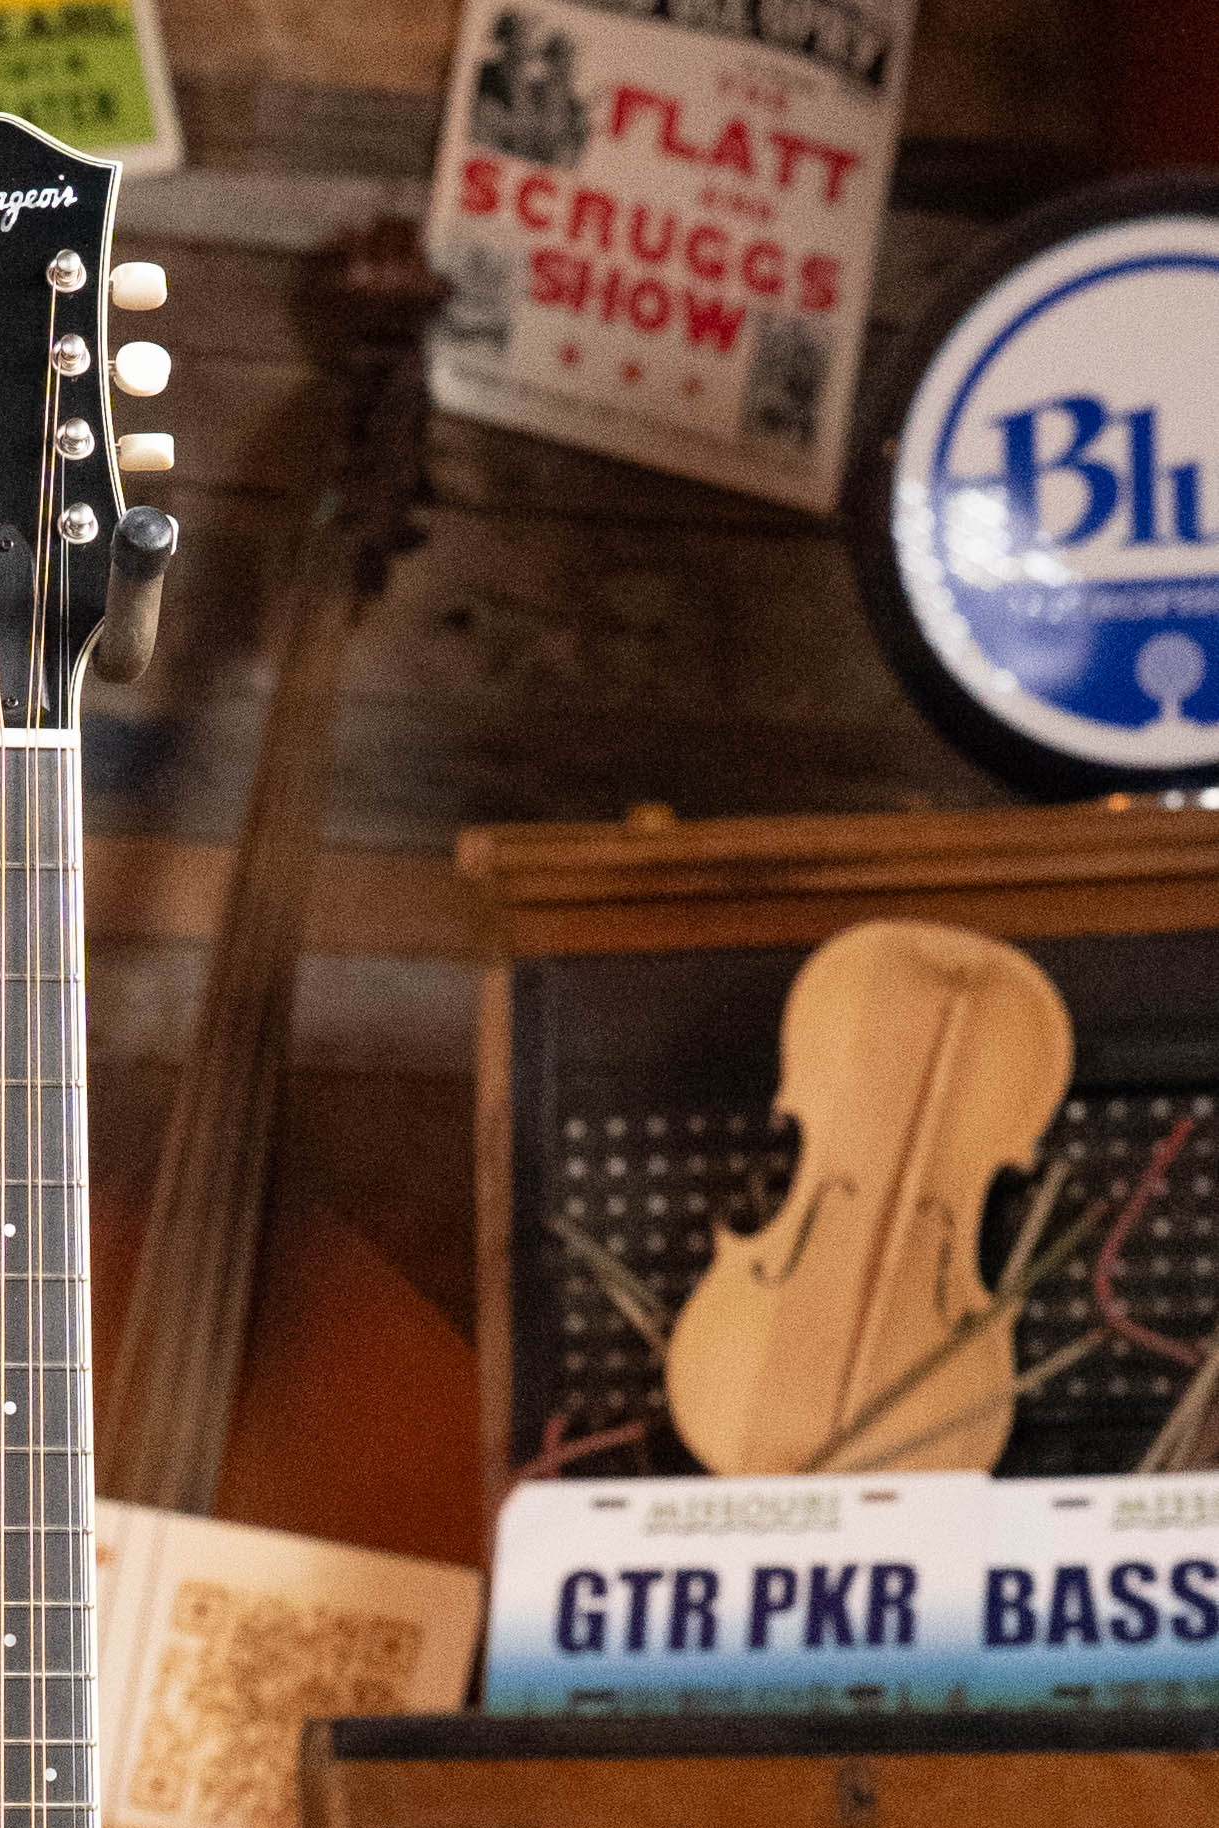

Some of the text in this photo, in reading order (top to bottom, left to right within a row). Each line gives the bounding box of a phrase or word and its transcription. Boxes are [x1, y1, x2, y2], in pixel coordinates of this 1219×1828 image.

[610, 84, 860, 203] FLATT
[459, 157, 840, 313] SCRUGGS
[529, 248, 746, 352] SHOW
[556, 1562, 919, 1655] GTR PKR
[984, 1559, 1219, 1649] BASS
